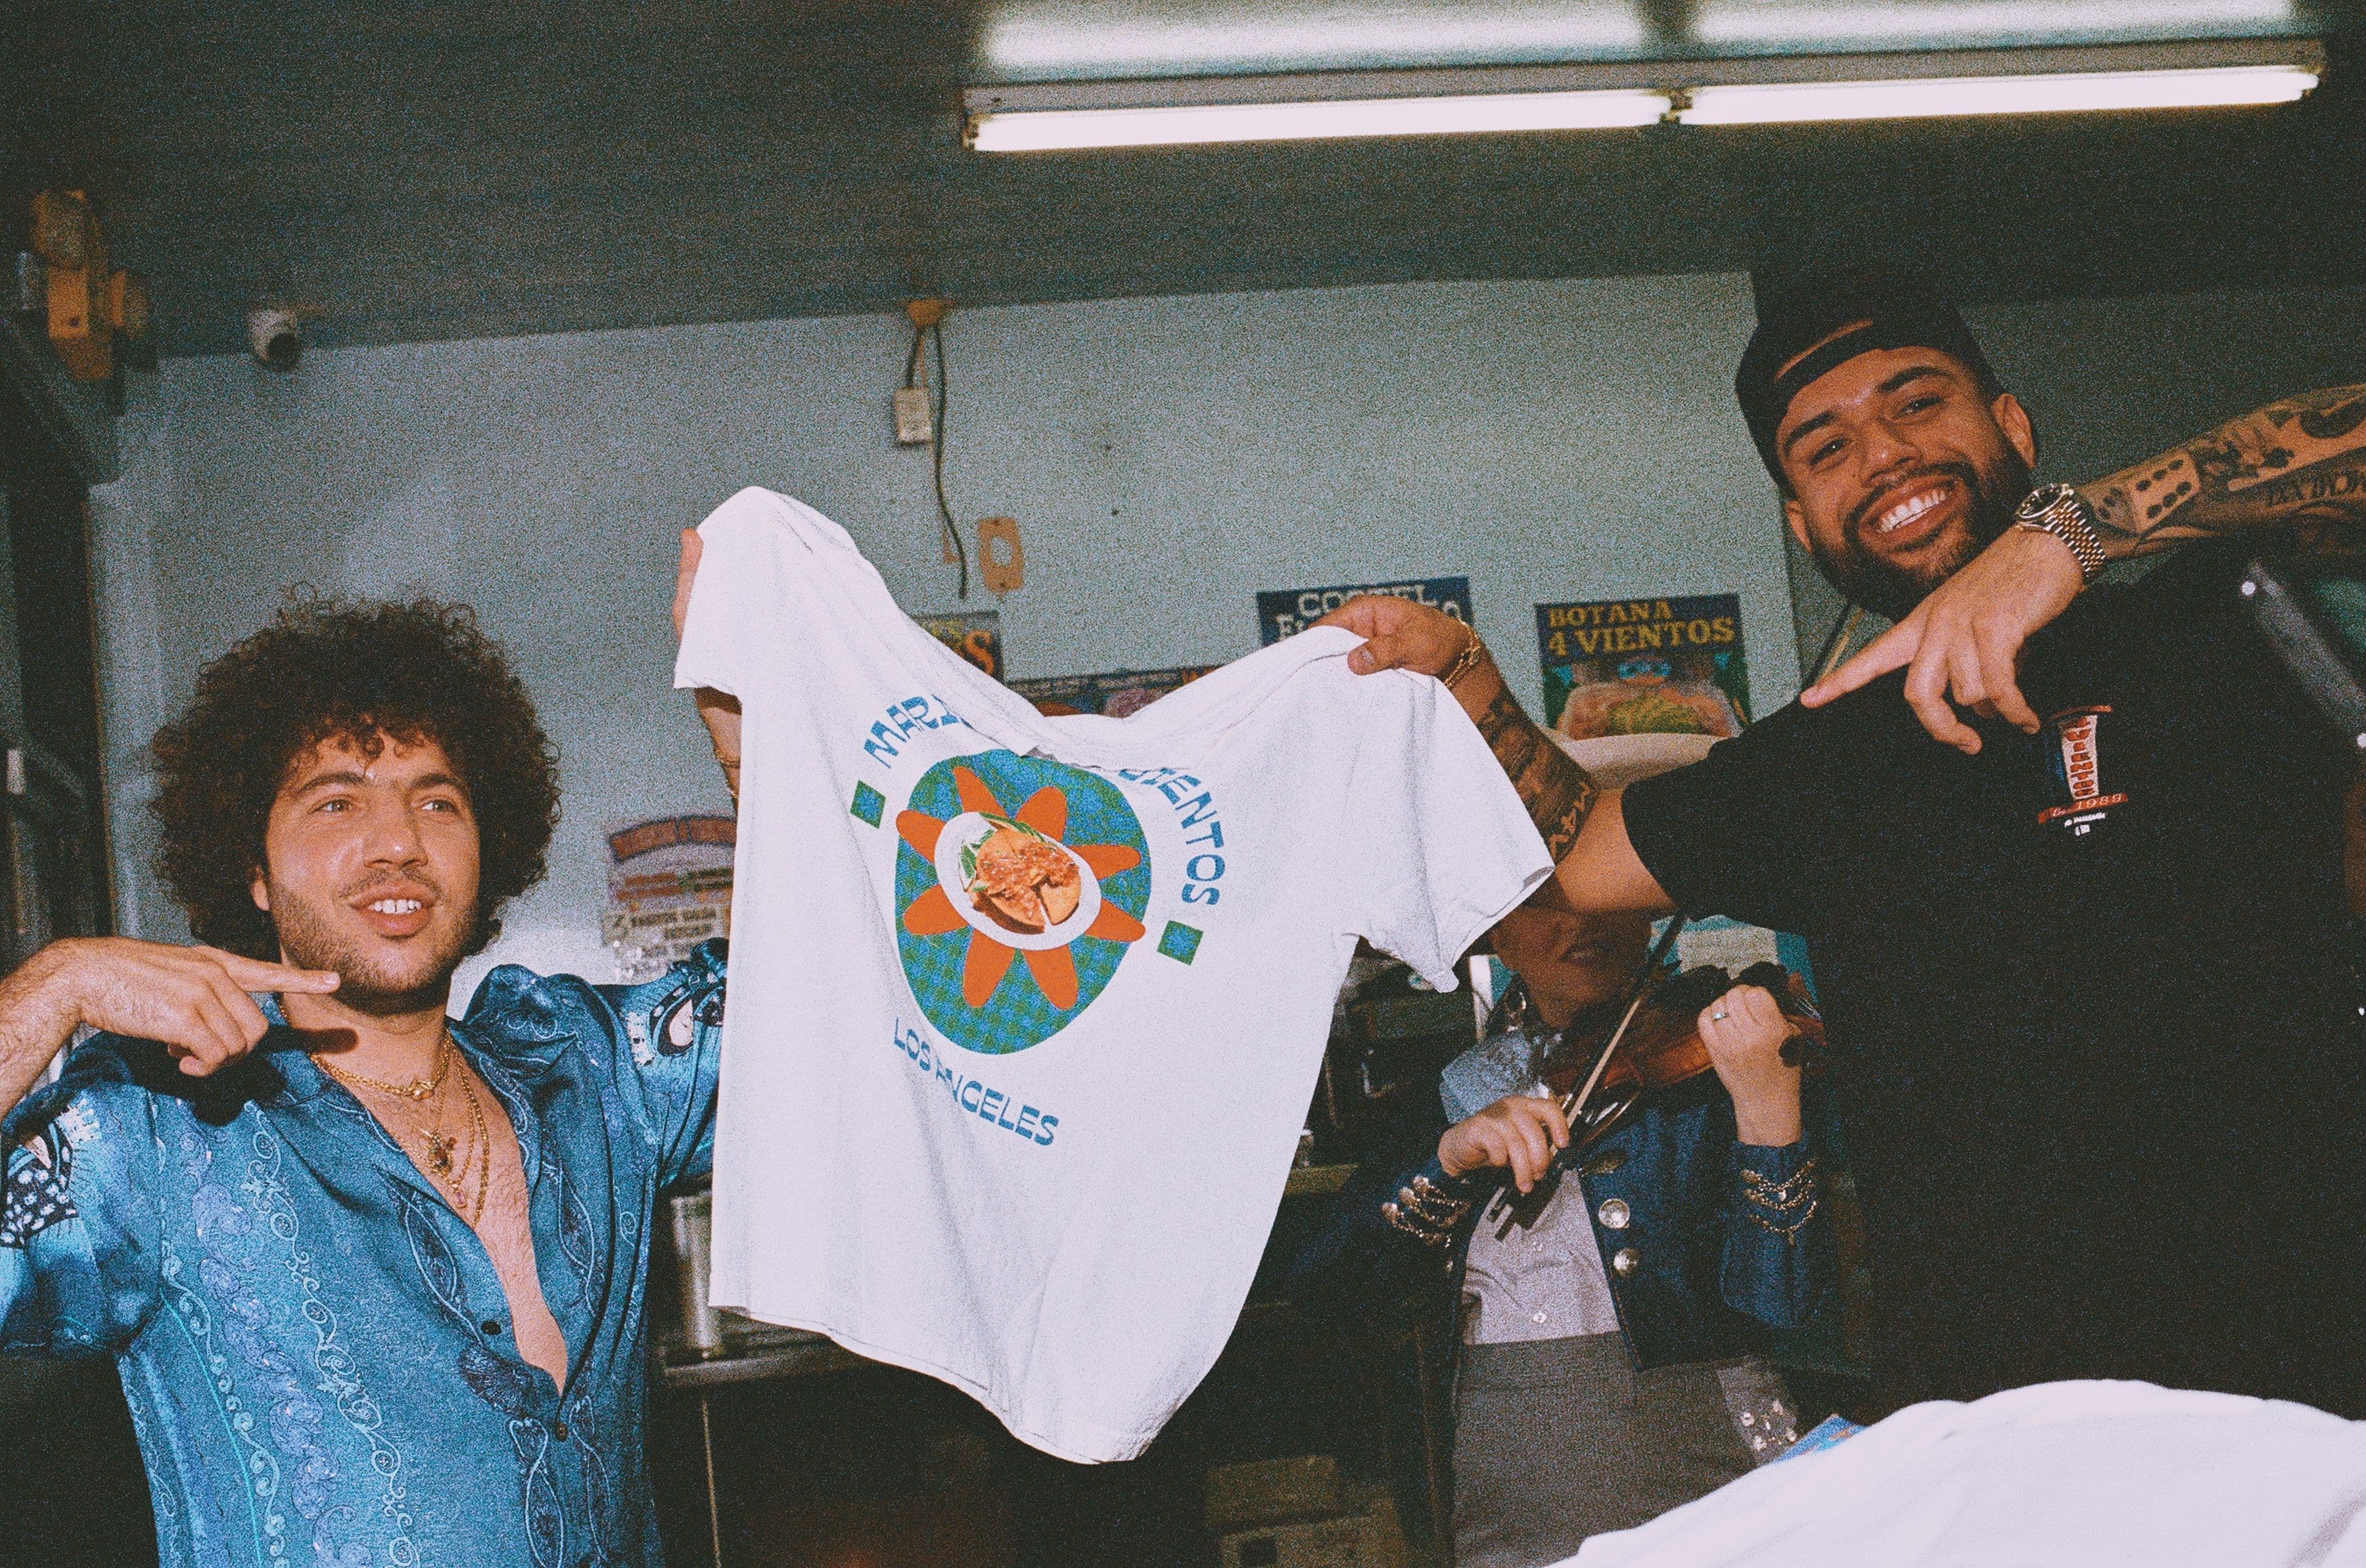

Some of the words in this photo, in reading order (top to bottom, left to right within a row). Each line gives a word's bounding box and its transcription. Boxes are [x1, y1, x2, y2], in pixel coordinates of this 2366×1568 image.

[1548, 600, 1673, 628] BOTANA
[1548, 630, 1567, 657] 4
[1574, 616, 1736, 655] VIENTOS
[2077, 793, 2122, 810] 1989
[893, 1016, 931, 1071] LOS
[935, 1053, 1059, 1146] ANGELES
